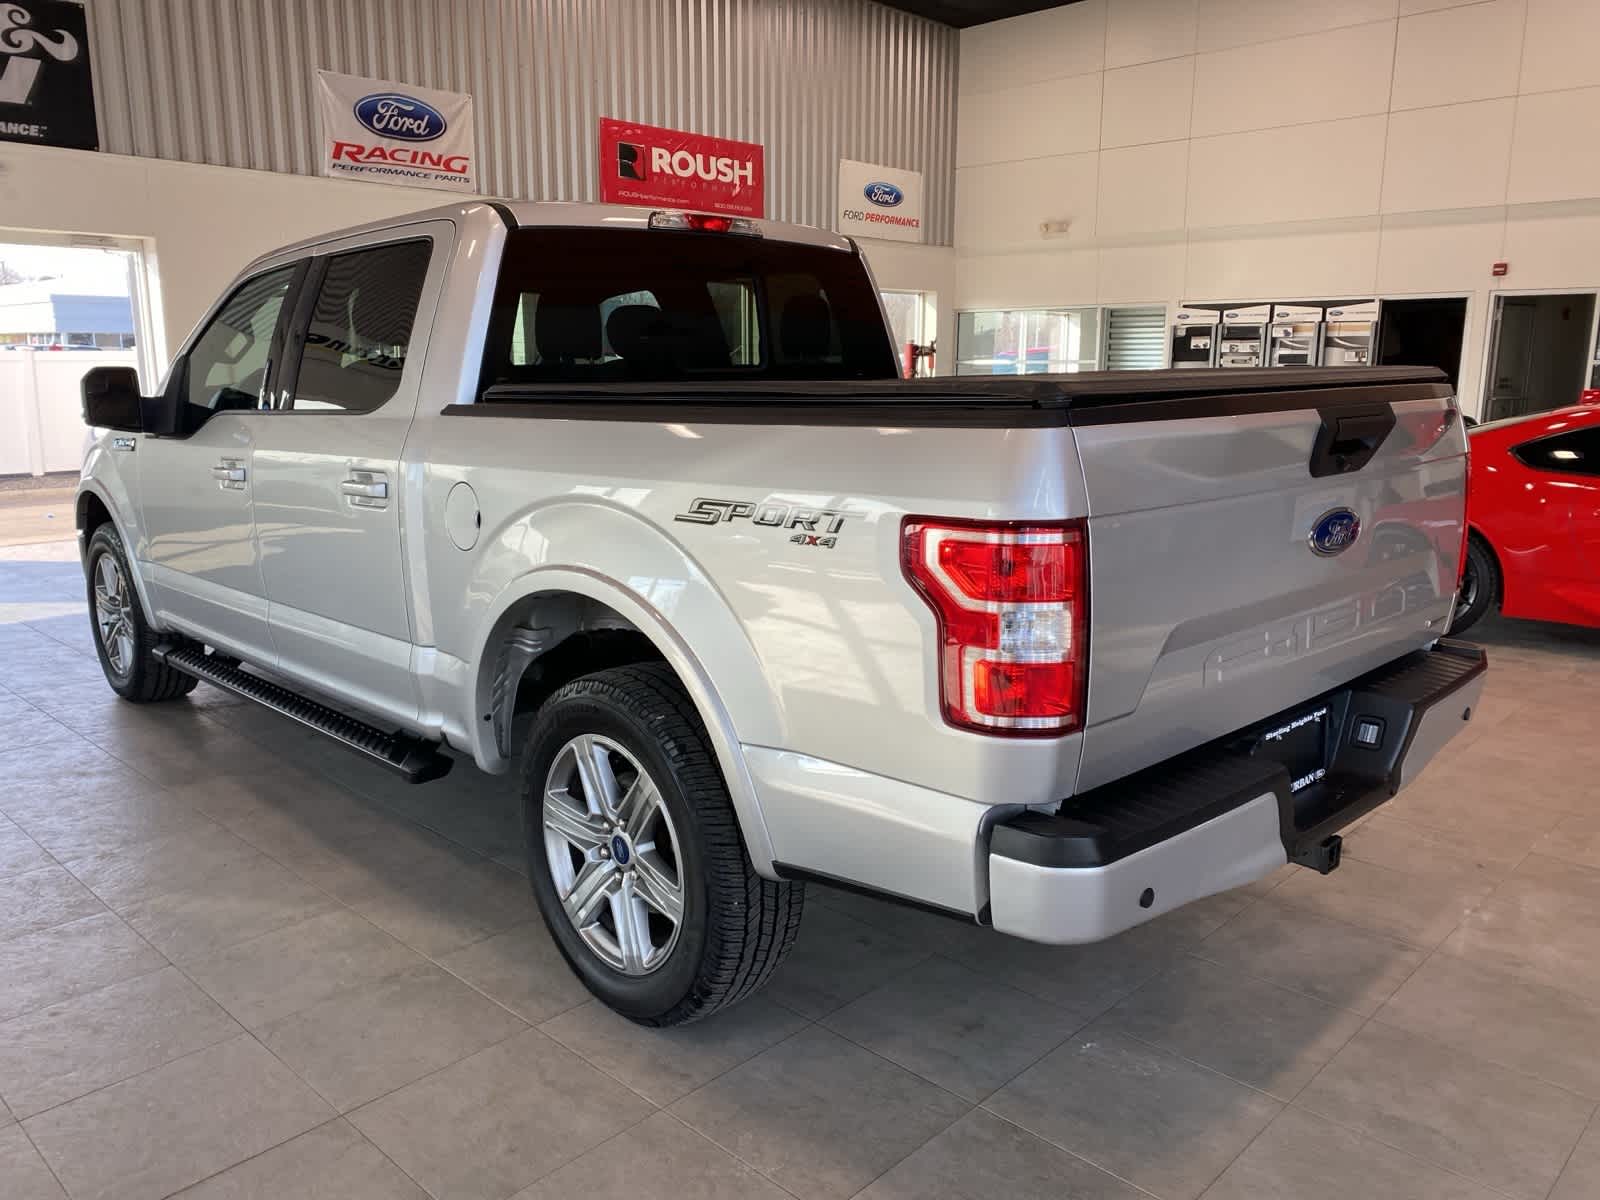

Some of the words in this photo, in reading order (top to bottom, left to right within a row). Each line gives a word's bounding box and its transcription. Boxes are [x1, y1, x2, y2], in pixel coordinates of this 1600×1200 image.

[372, 99, 430, 136] Ford
[332, 141, 470, 173] RACING
[332, 162, 432, 179] PERFORMANCE
[434, 174, 471, 184] PARTS
[651, 147, 753, 187] ROUSH
[843, 210, 864, 221] FORD
[865, 212, 920, 228] PERFORMANCE
[674, 497, 845, 533] SPORT
